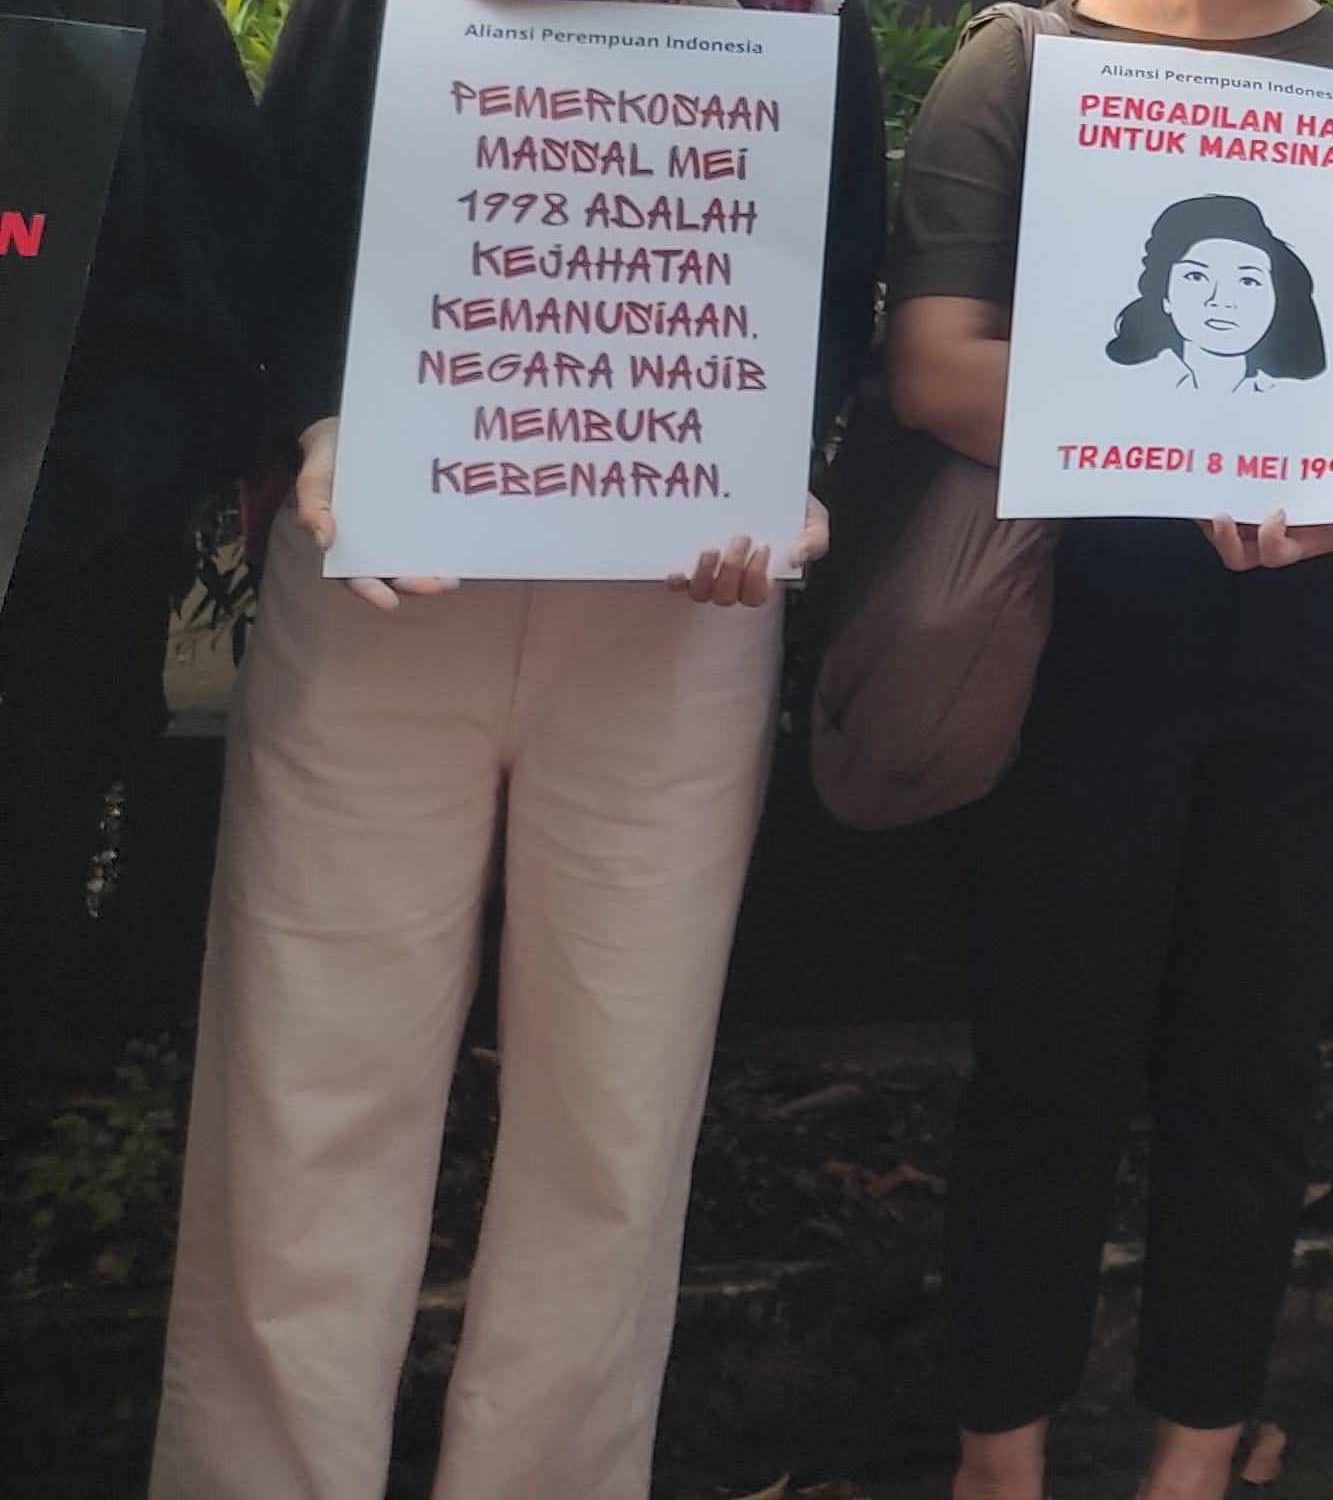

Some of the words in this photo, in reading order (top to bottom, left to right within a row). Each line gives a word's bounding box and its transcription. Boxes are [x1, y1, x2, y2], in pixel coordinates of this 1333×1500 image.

[465, 23, 535, 43] Aliansi
[541, 27, 660, 52] Perempuan
[665, 34, 764, 55] Indonesia
[1101, 64, 1159, 81] Aliansi
[1165, 70, 1262, 92] Perempuan
[450, 80, 780, 132] PEMERKOSAAN
[1080, 94, 1283, 133] PENGADILAN
[476, 137, 654, 177] MASSAL
[1079, 124, 1186, 154] UNTUK
[458, 191, 569, 226] 1998
[585, 193, 757, 235] ADALAH
[472, 242, 731, 285] KEJAHATAN
[419, 351, 613, 388] NEGARA
[474, 406, 701, 443] MEMBUKA
[432, 458, 730, 499] KEBENARAN.
[1058, 445, 1194, 473] TRAGEDI
[1206, 452, 1223, 474] 8
[1237, 455, 1288, 480] MEI
